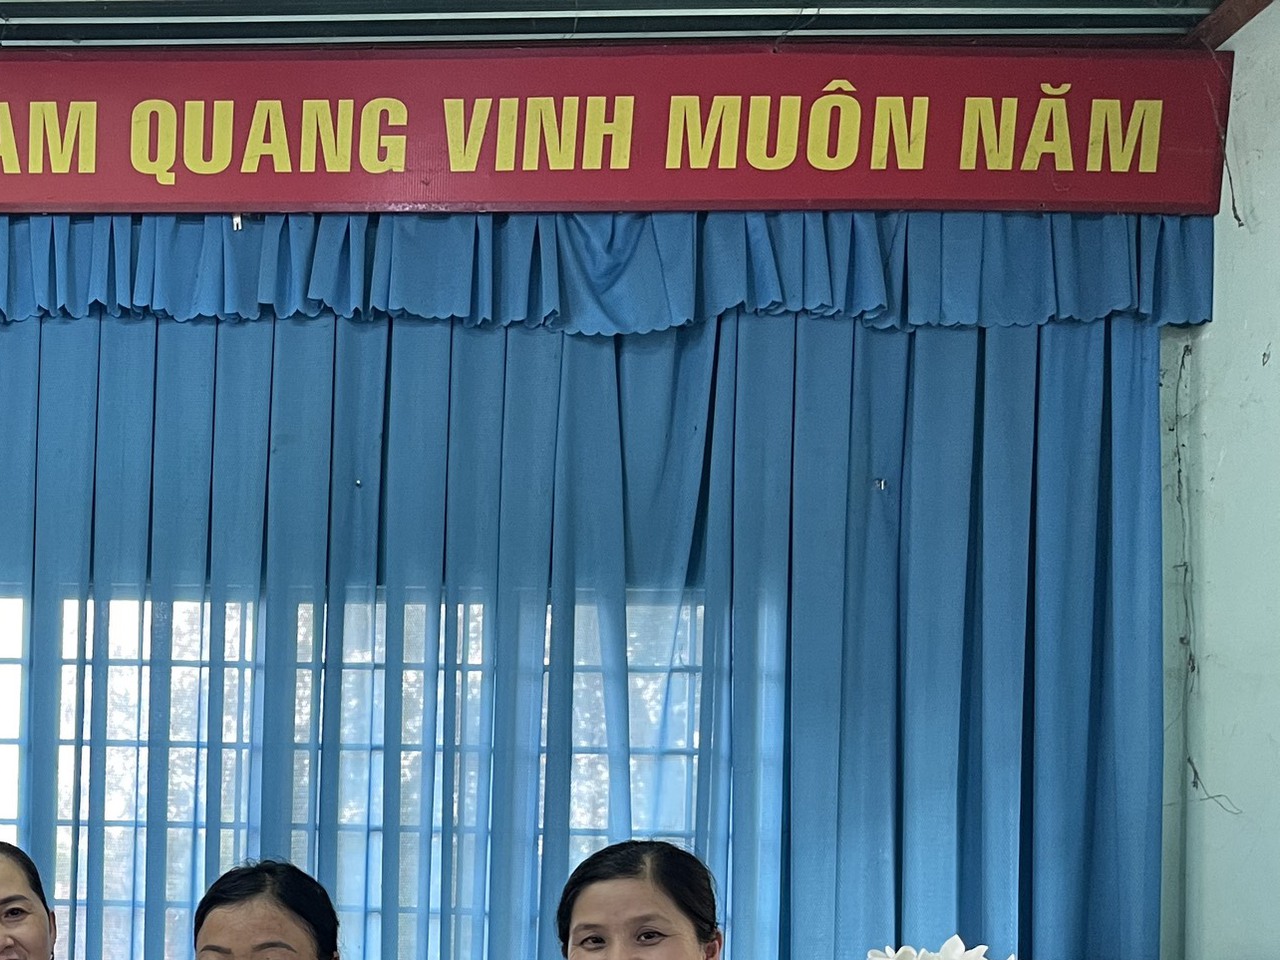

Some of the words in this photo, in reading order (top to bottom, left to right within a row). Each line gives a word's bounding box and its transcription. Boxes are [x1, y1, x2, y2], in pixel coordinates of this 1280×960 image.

[130, 98, 408, 185] QUANG
[444, 96, 634, 172] VINH
[666, 79, 929, 171] MUÔN
[960, 84, 1163, 173] NĂM
